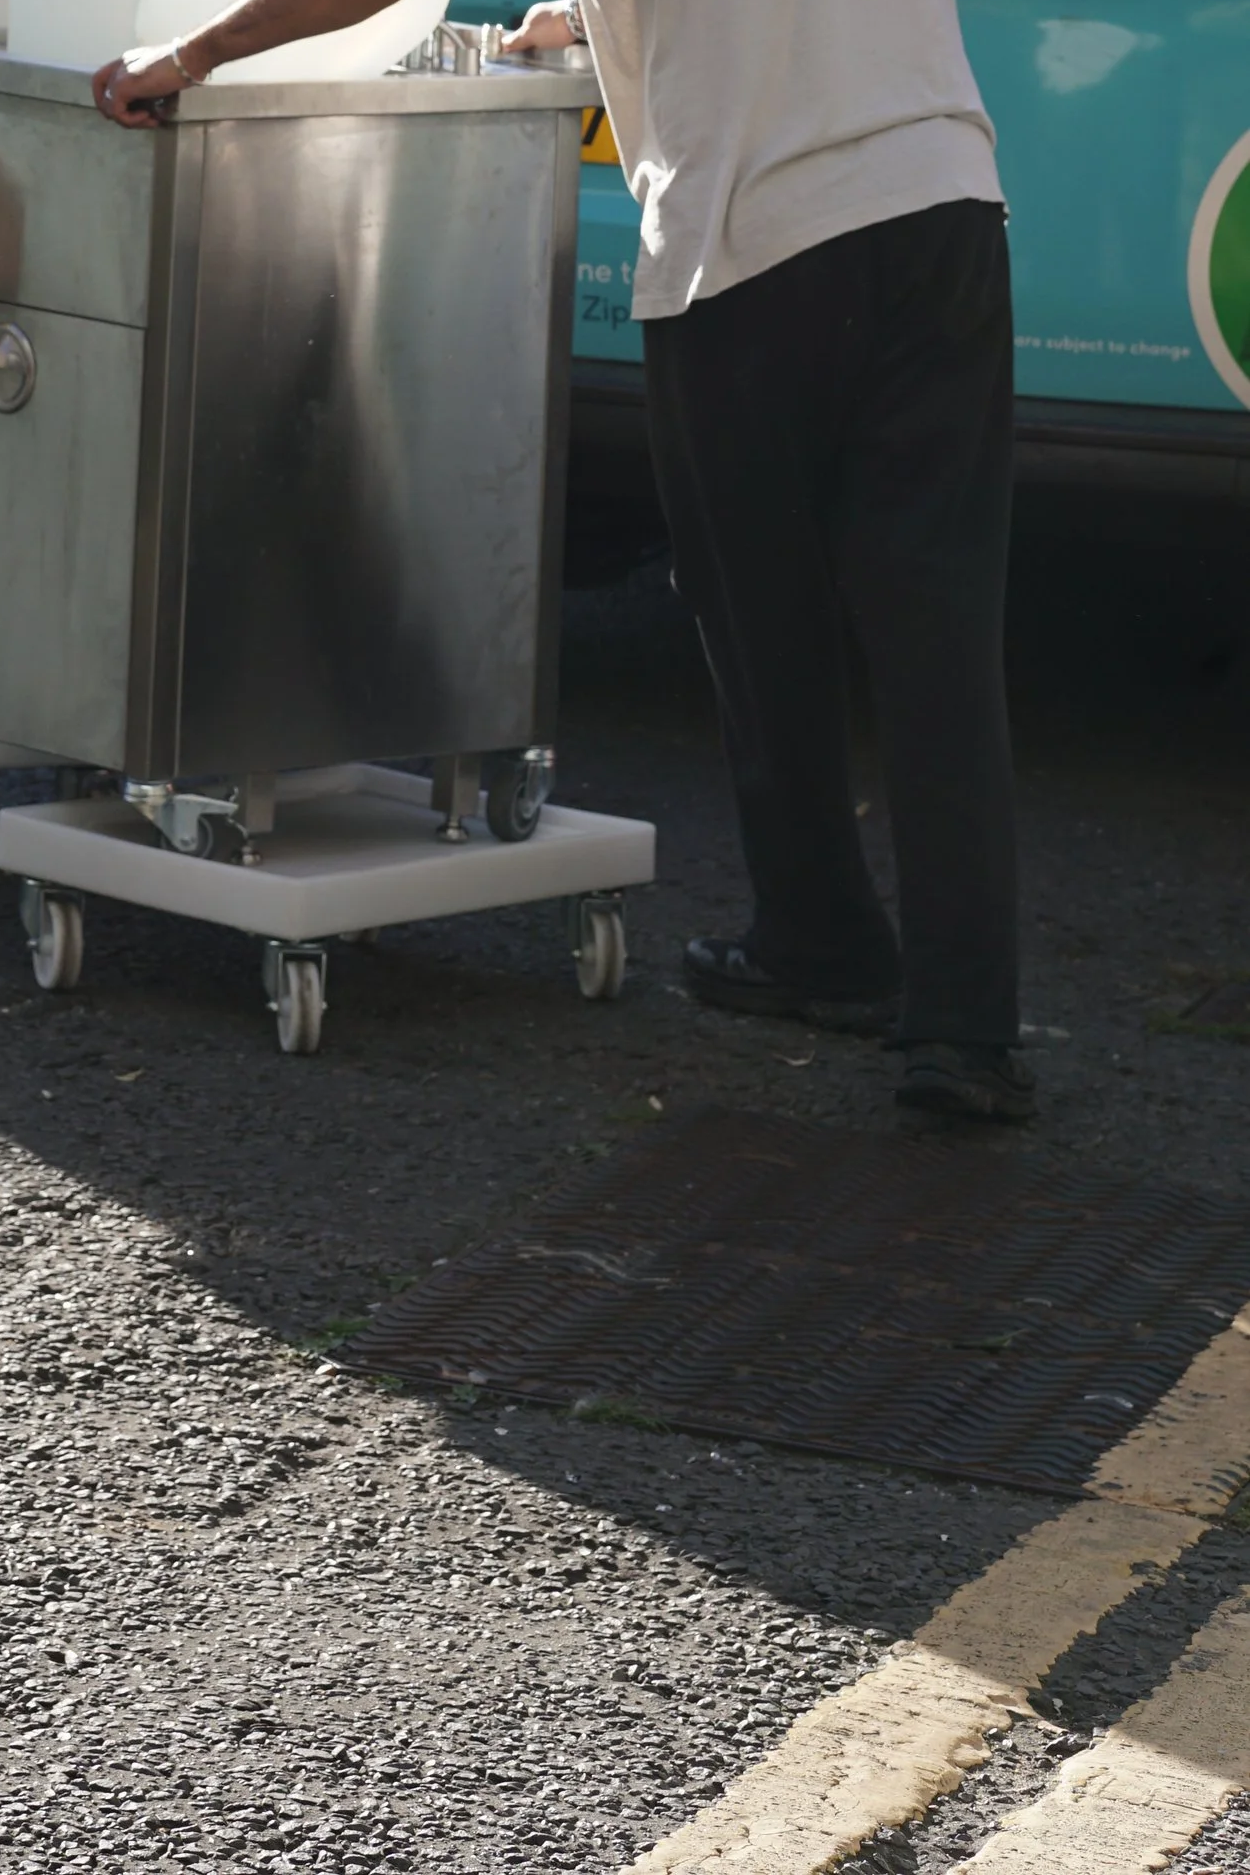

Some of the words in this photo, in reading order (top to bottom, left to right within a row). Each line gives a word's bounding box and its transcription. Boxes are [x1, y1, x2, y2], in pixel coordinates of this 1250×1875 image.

[1046, 336, 1104, 353] subject
[1109, 340, 1125, 354] to
[1130, 341, 1191, 362] change
